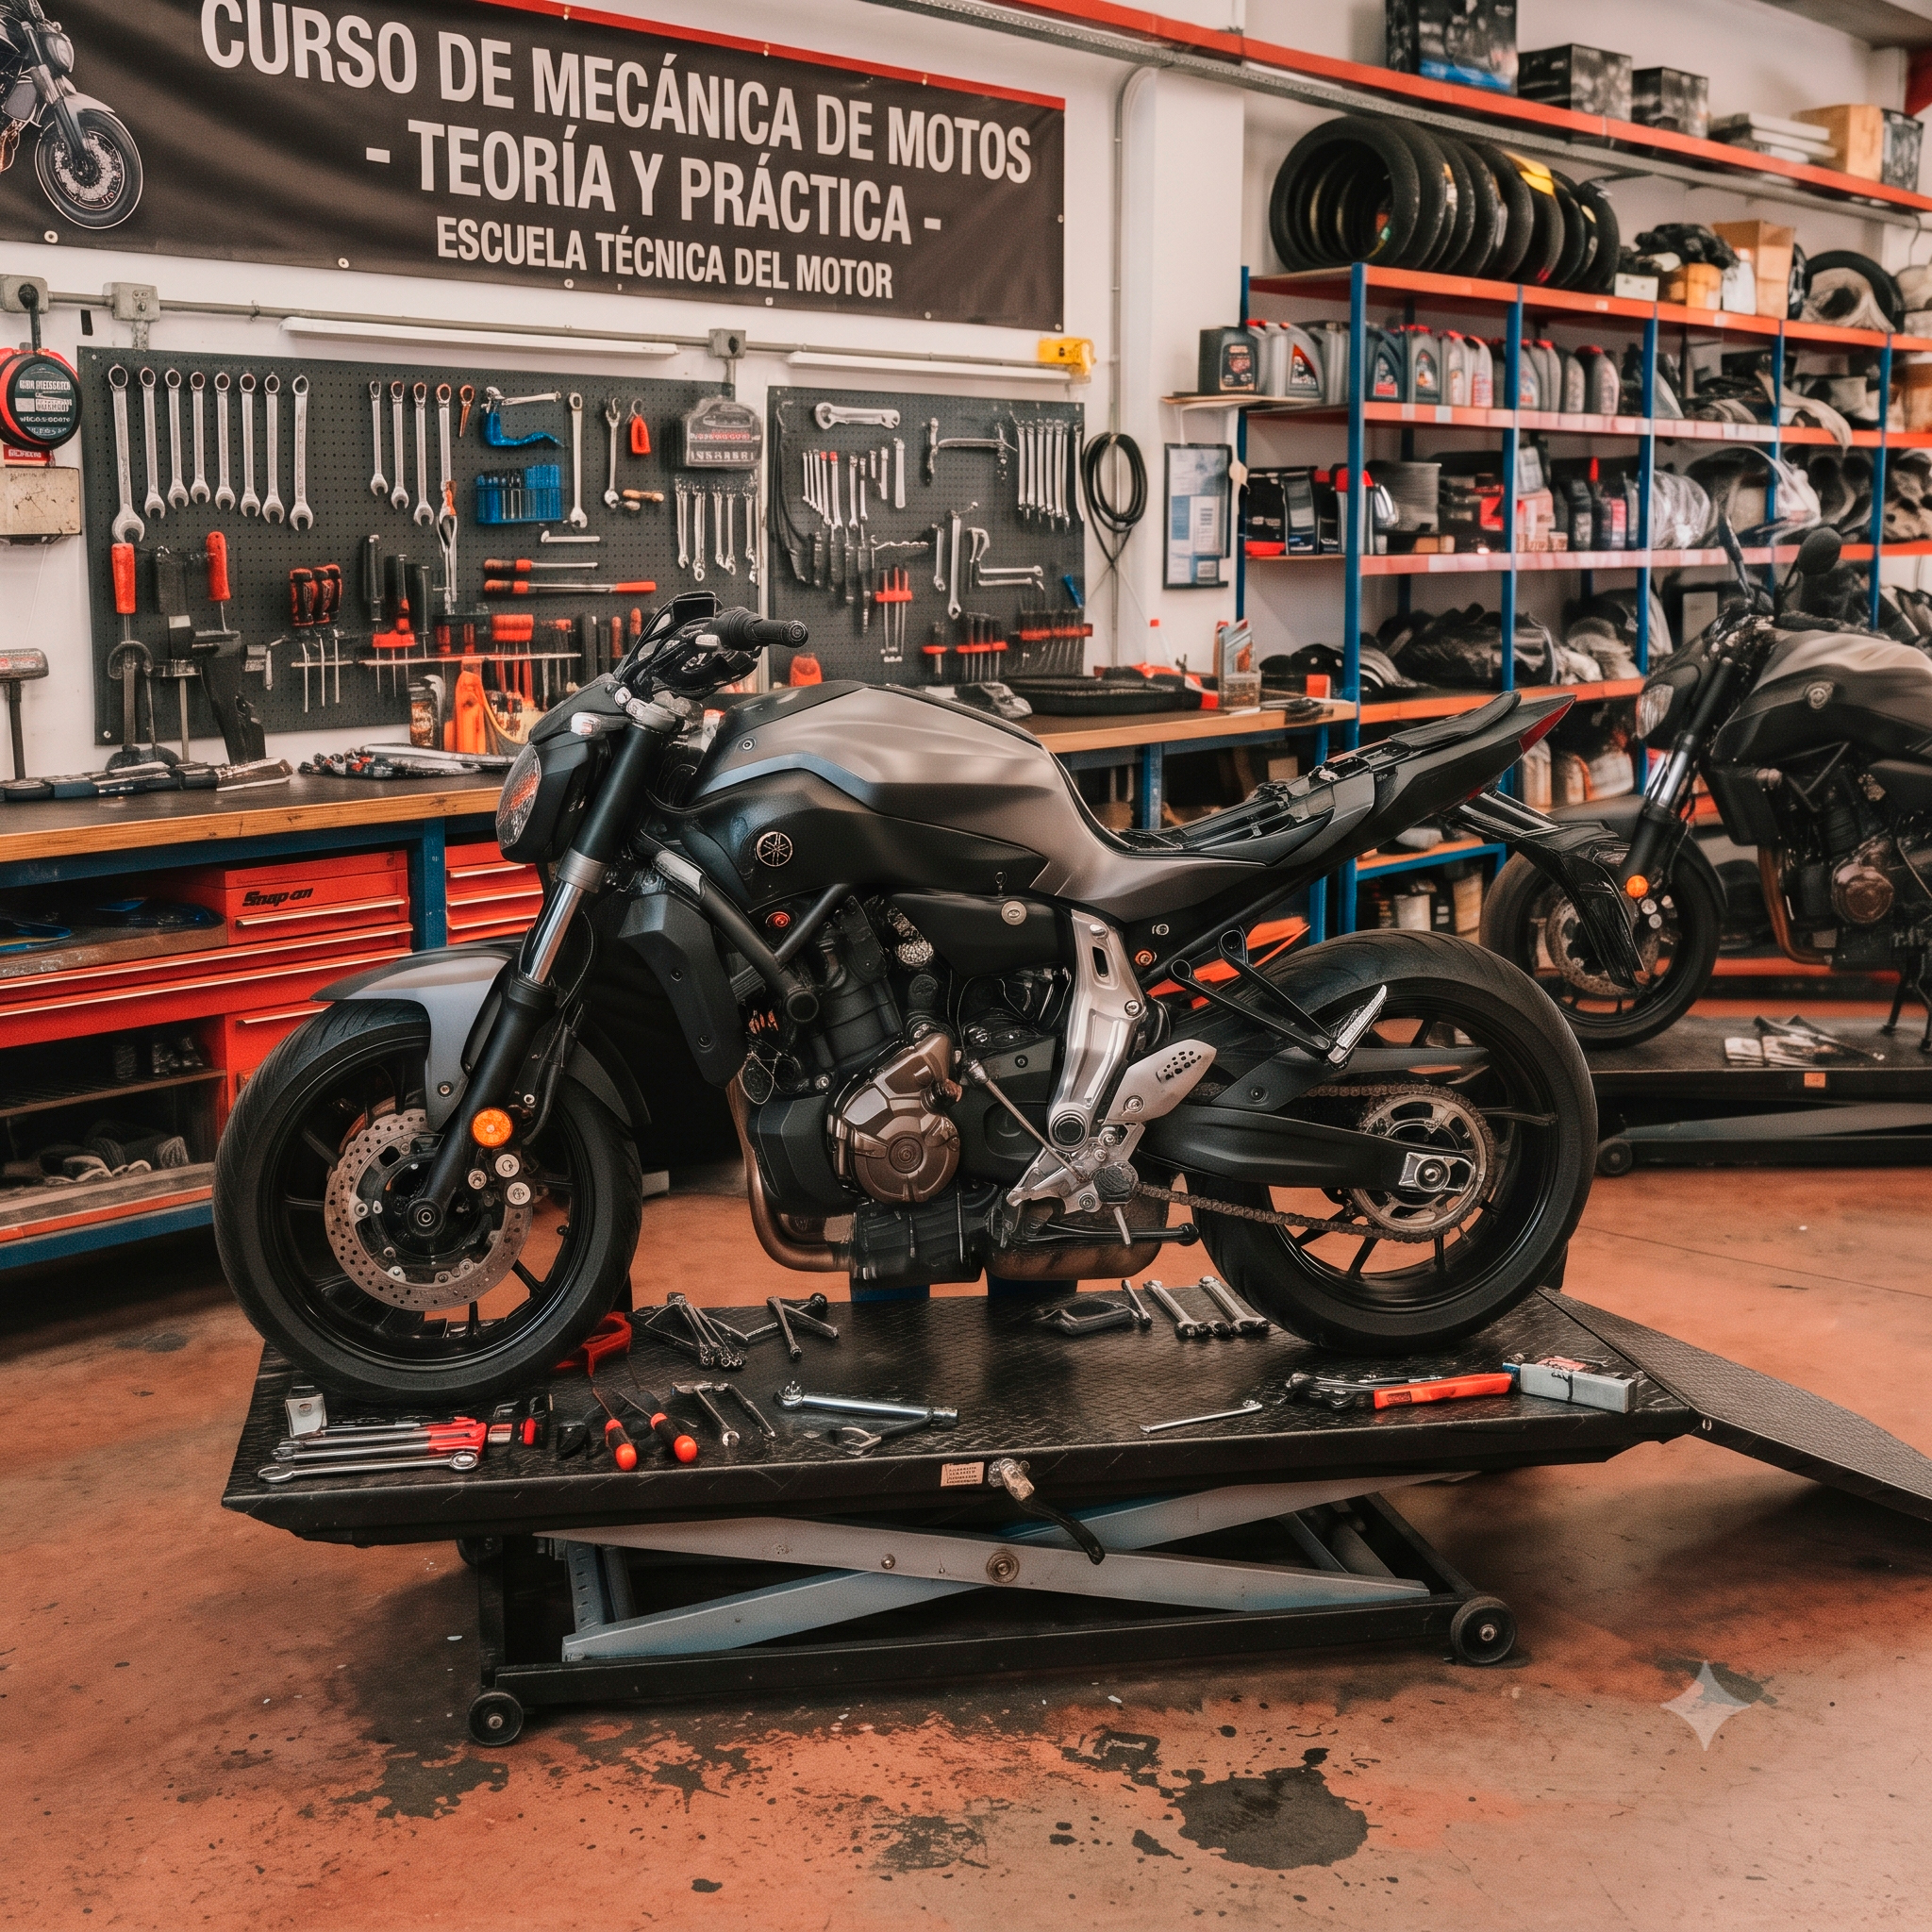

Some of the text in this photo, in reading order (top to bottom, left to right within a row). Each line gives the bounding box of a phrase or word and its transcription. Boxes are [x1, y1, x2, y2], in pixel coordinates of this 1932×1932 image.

[200, 0, 1033, 184] CURSO DE MECÁNICA DE MOTOS
[408, 119, 616, 212] TEORÍA
[628, 149, 664, 216] Y
[680, 152, 912, 245] PRÁCTICA
[436, 215, 893, 299] ESCUELA TÉCNICA DEL MOTOR
